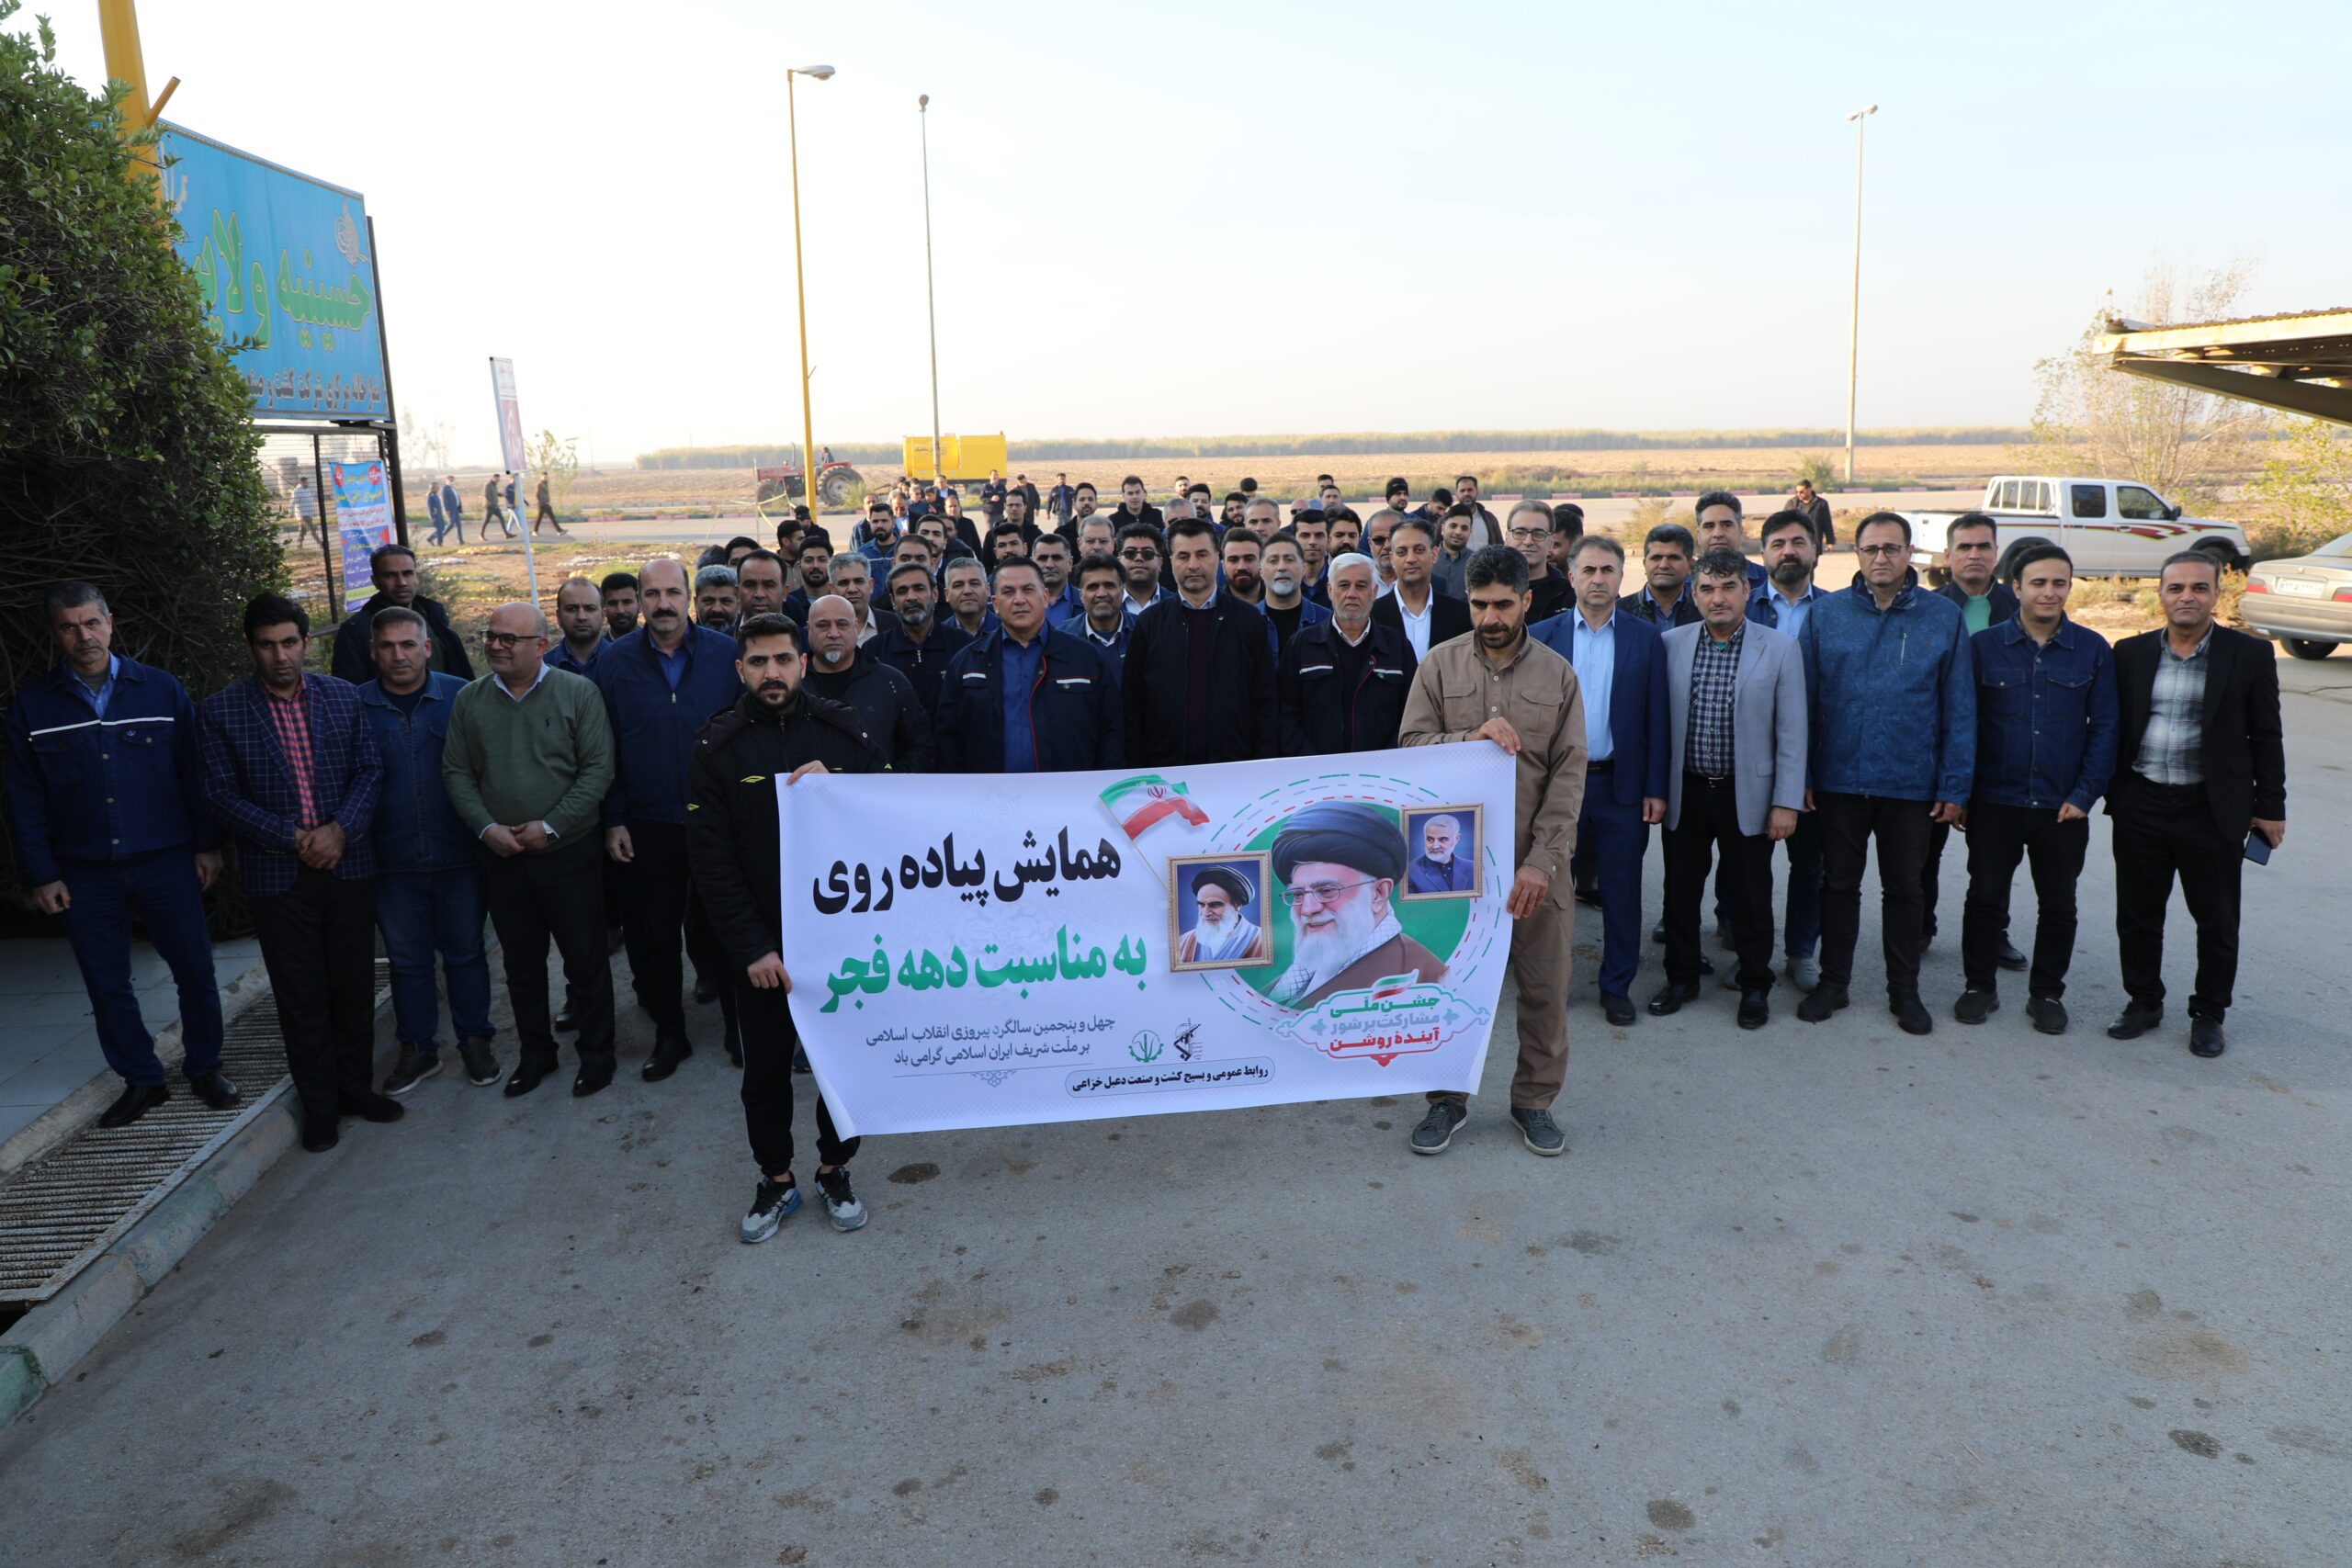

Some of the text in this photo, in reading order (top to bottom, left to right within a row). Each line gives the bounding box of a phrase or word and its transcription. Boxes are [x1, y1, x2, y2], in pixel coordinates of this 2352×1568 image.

[189, 208, 270, 349] ولای
[277, 247, 369, 351] حسینیه
[994, 826, 1121, 902] همایش
[820, 924, 1148, 1013] به مناسبت دهه فجر
[865, 1014, 1115, 1046] چهل و پنجمین سالگرد پیروزی انقلاب اسلامی
[988, 1042, 1012, 1060] ایران
[1015, 1041, 1049, 1057] شریف
[1078, 1041, 1091, 1055] بر
[1329, 1033, 1392, 1052] روشن
[894, 1049, 909, 1066] باد
[910, 1045, 944, 1066] گرامی
[944, 1044, 987, 1065] اسلامی
[1072, 1065, 1269, 1092] روابط عمومی و بسیج کشت و صنعت دعبل خزاعی
